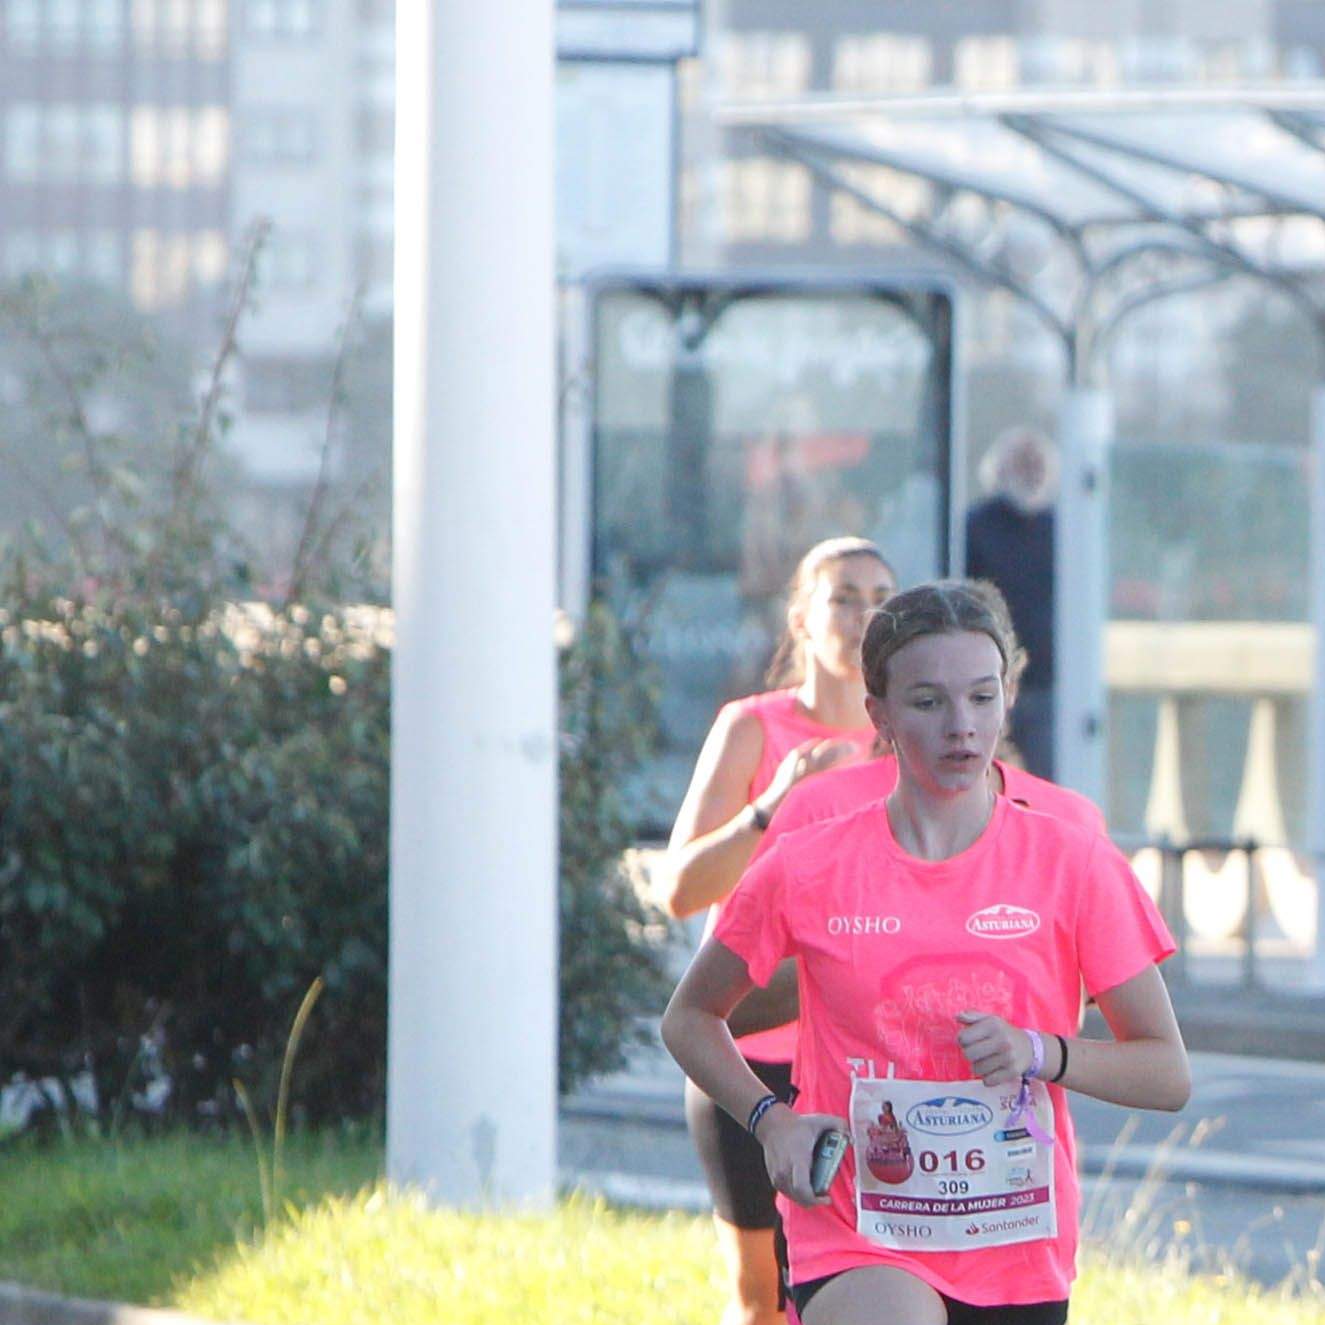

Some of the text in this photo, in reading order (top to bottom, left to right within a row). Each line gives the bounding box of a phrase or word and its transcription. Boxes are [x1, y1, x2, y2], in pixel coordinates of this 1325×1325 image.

[828, 916, 901, 935] OYSHO
[969, 914, 1035, 933] ASTURIANA
[913, 1110, 987, 1126] ASTURIANA
[919, 1149, 985, 1173] 016
[938, 1180, 969, 1196] 309
[879, 1193, 1035, 1213] CARRERA DE LA MUJER 2023
[874, 1215, 1041, 1239] OYSHO Santander
